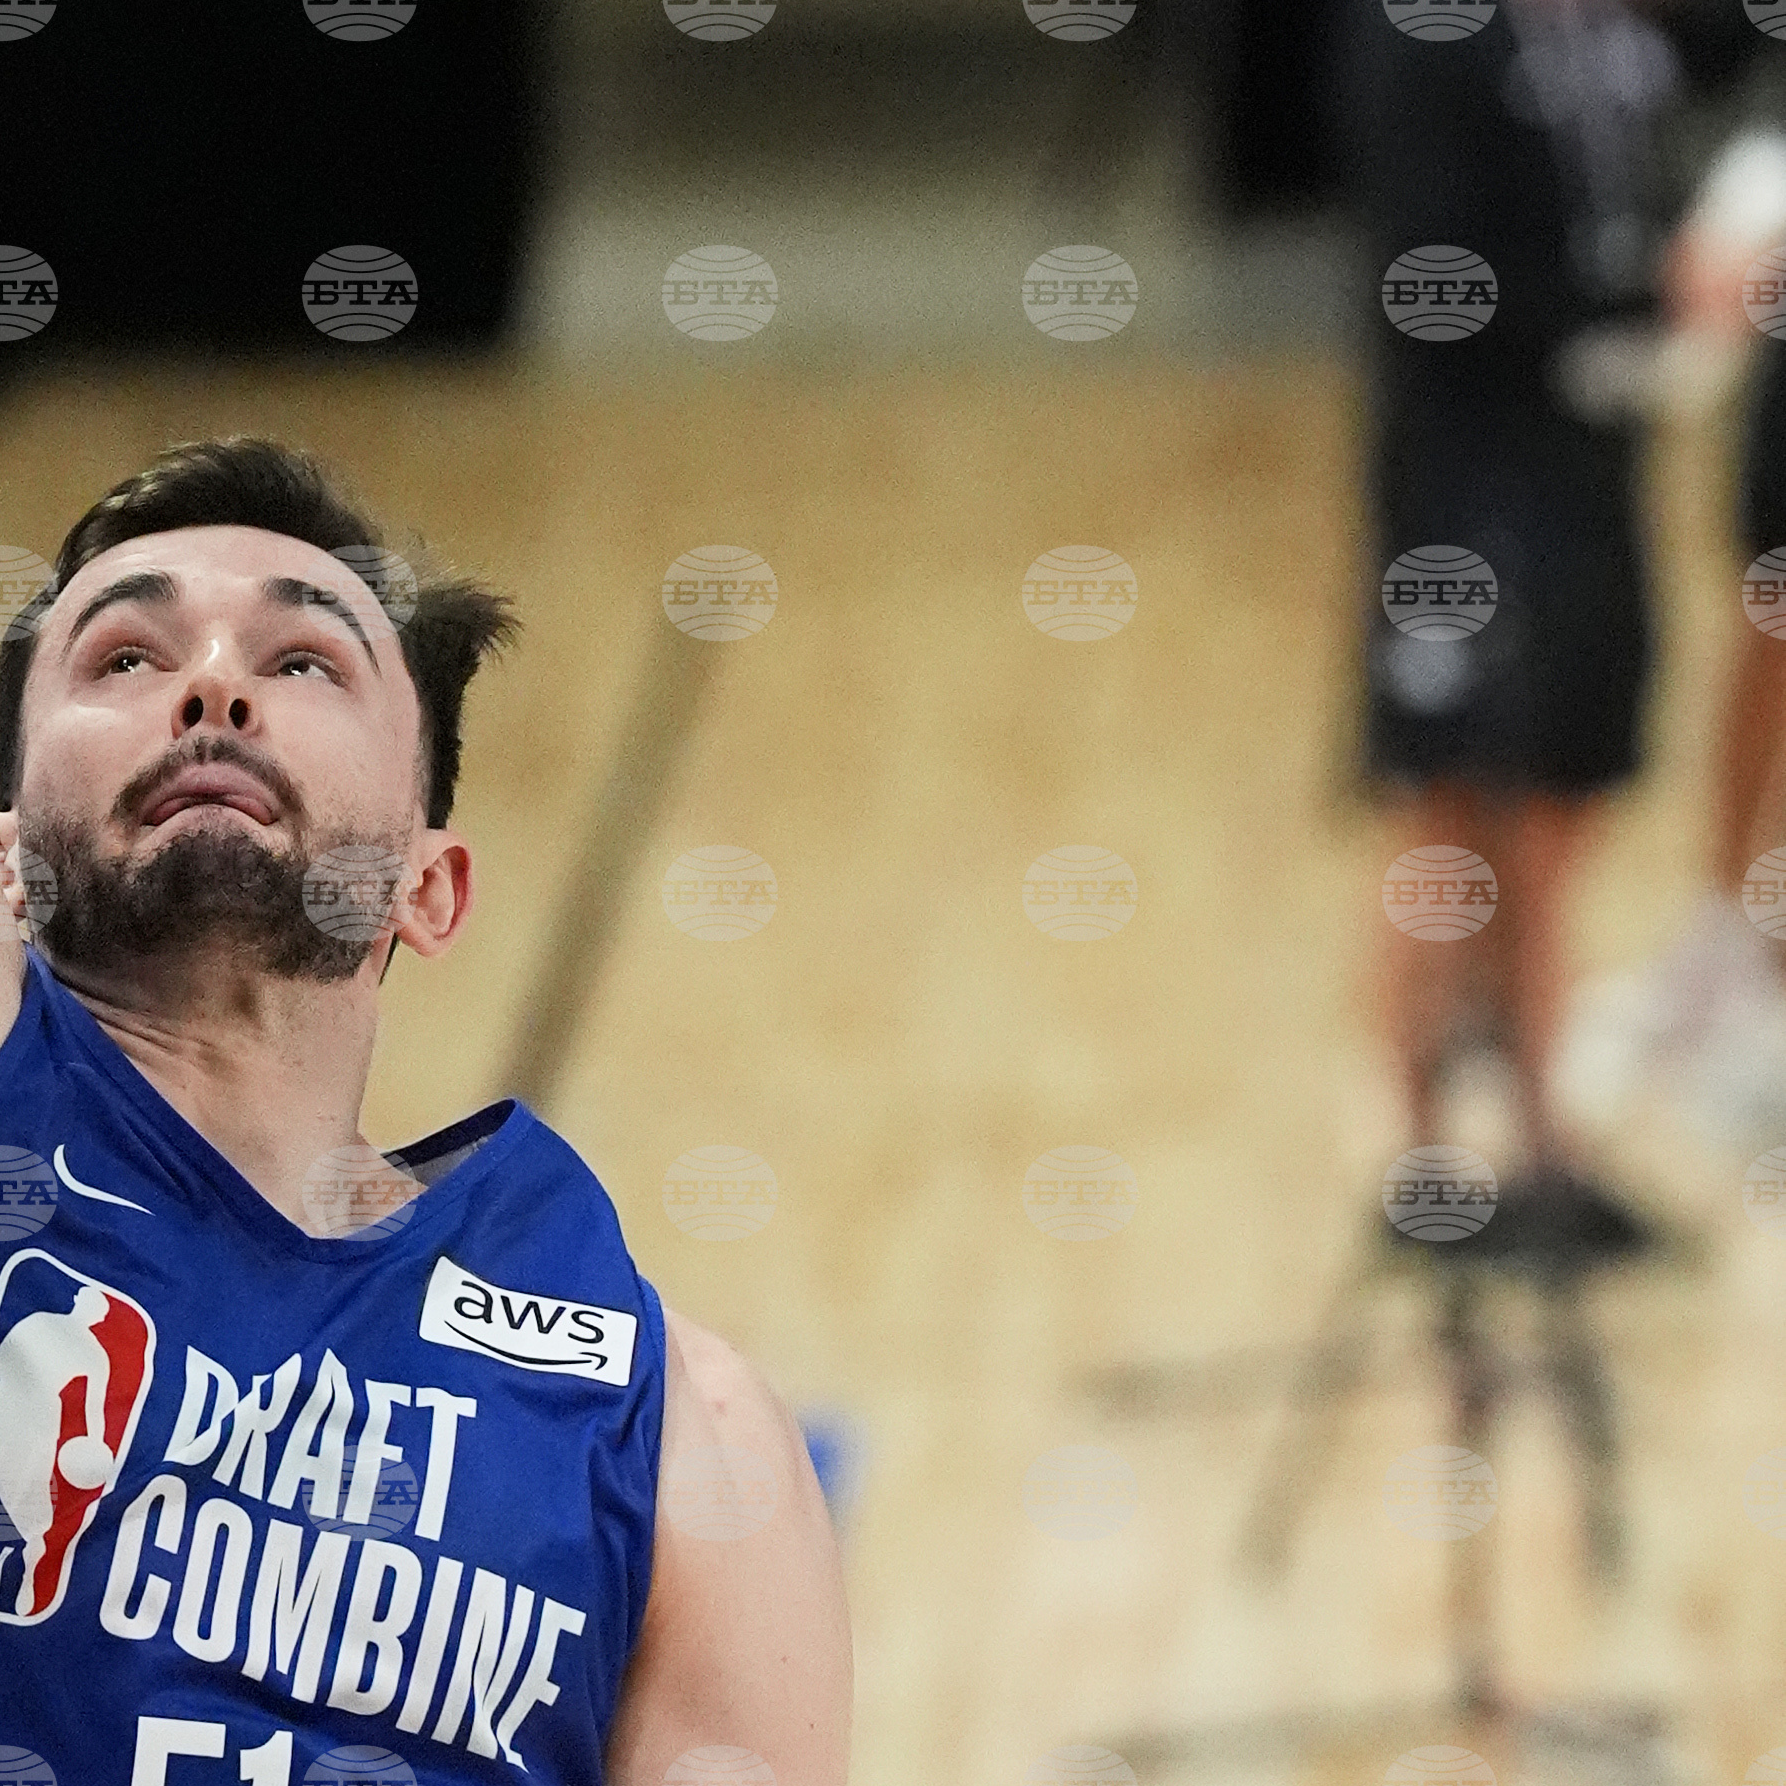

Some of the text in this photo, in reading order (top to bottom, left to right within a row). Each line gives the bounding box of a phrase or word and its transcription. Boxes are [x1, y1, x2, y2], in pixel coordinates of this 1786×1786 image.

[454, 1278, 606, 1343] aws
[165, 1347, 476, 1541] DRAFT
[100, 1476, 586, 1772] COMBINE
